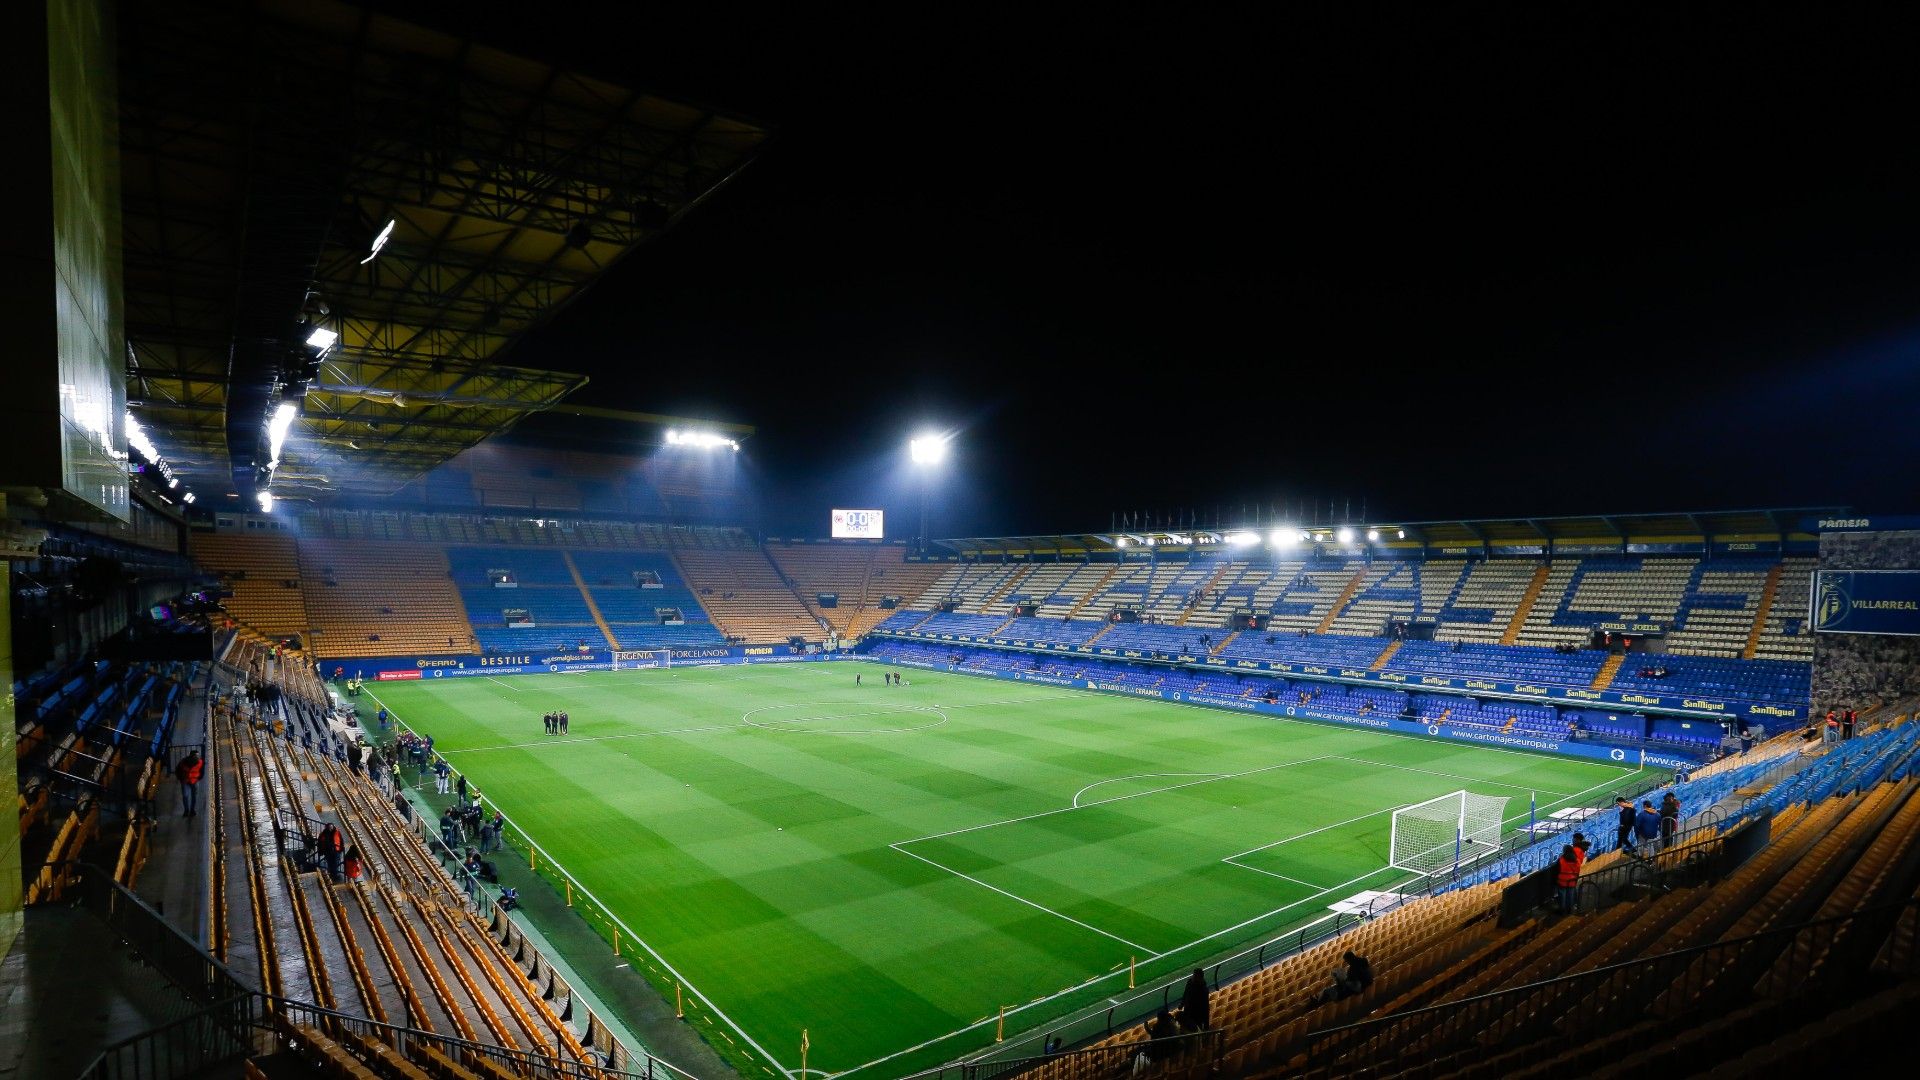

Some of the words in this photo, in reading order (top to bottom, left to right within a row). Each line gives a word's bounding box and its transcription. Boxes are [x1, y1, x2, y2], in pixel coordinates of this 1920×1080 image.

[1818, 519, 1870, 528] PAMESA
[1852, 600, 1919, 611] VILLARREAL
[671, 649, 729, 658] PORCELANOSA
[481, 656, 530, 666] BESTILE
[1188, 695, 1256, 710] www.cartonajeseuropa.es
[1306, 710, 1389, 728] www.cartonajeseuropa.es
[1452, 729, 1559, 751] www.cartonajeseuropa.es
